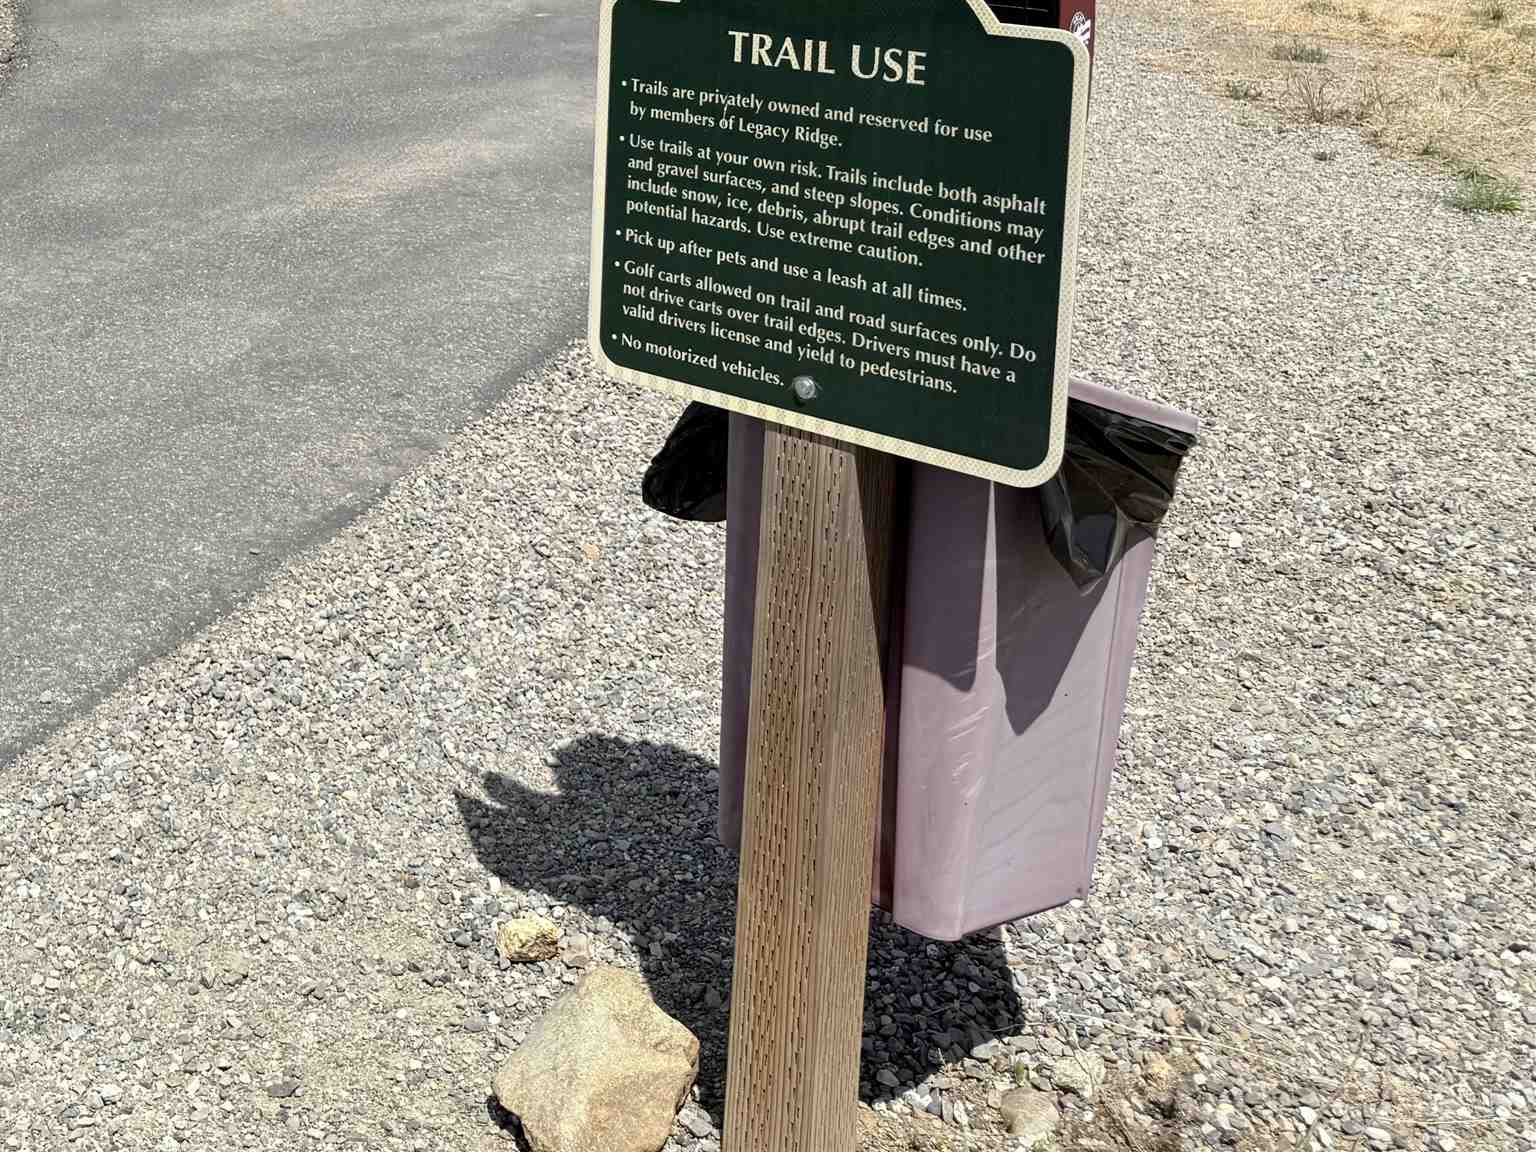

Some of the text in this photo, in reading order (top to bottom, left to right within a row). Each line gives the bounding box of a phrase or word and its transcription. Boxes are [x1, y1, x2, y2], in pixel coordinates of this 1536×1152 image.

[727, 30, 927, 86] TRAIL USE
[629, 100, 843, 150] by members of Legacy Ridge.
[630, 78, 993, 143] Trails are privately owned and reserved for use
[627, 156, 1045, 244] and gravel surfaces, and steep slopes. Conditions may
[629, 133, 1047, 216] Use trails at your own risk. Trails include both asphalt
[626, 199, 923, 267] potential hazards. Use extreme caution.
[627, 174, 1046, 265] include snow, ice, debris, abrupt trail edges and other
[623, 260, 1037, 362] Golf carts allowed on trail and road surfaces only. Do
[625, 228, 967, 312] Pick up after pets and use a leash at all times.
[621, 332, 785, 387] No motorized vehicles.
[622, 303, 957, 394] valid drivers license and yield to pedestrians.
[623, 283, 1016, 383] not drive carts over trail edges. Drivers must have a
